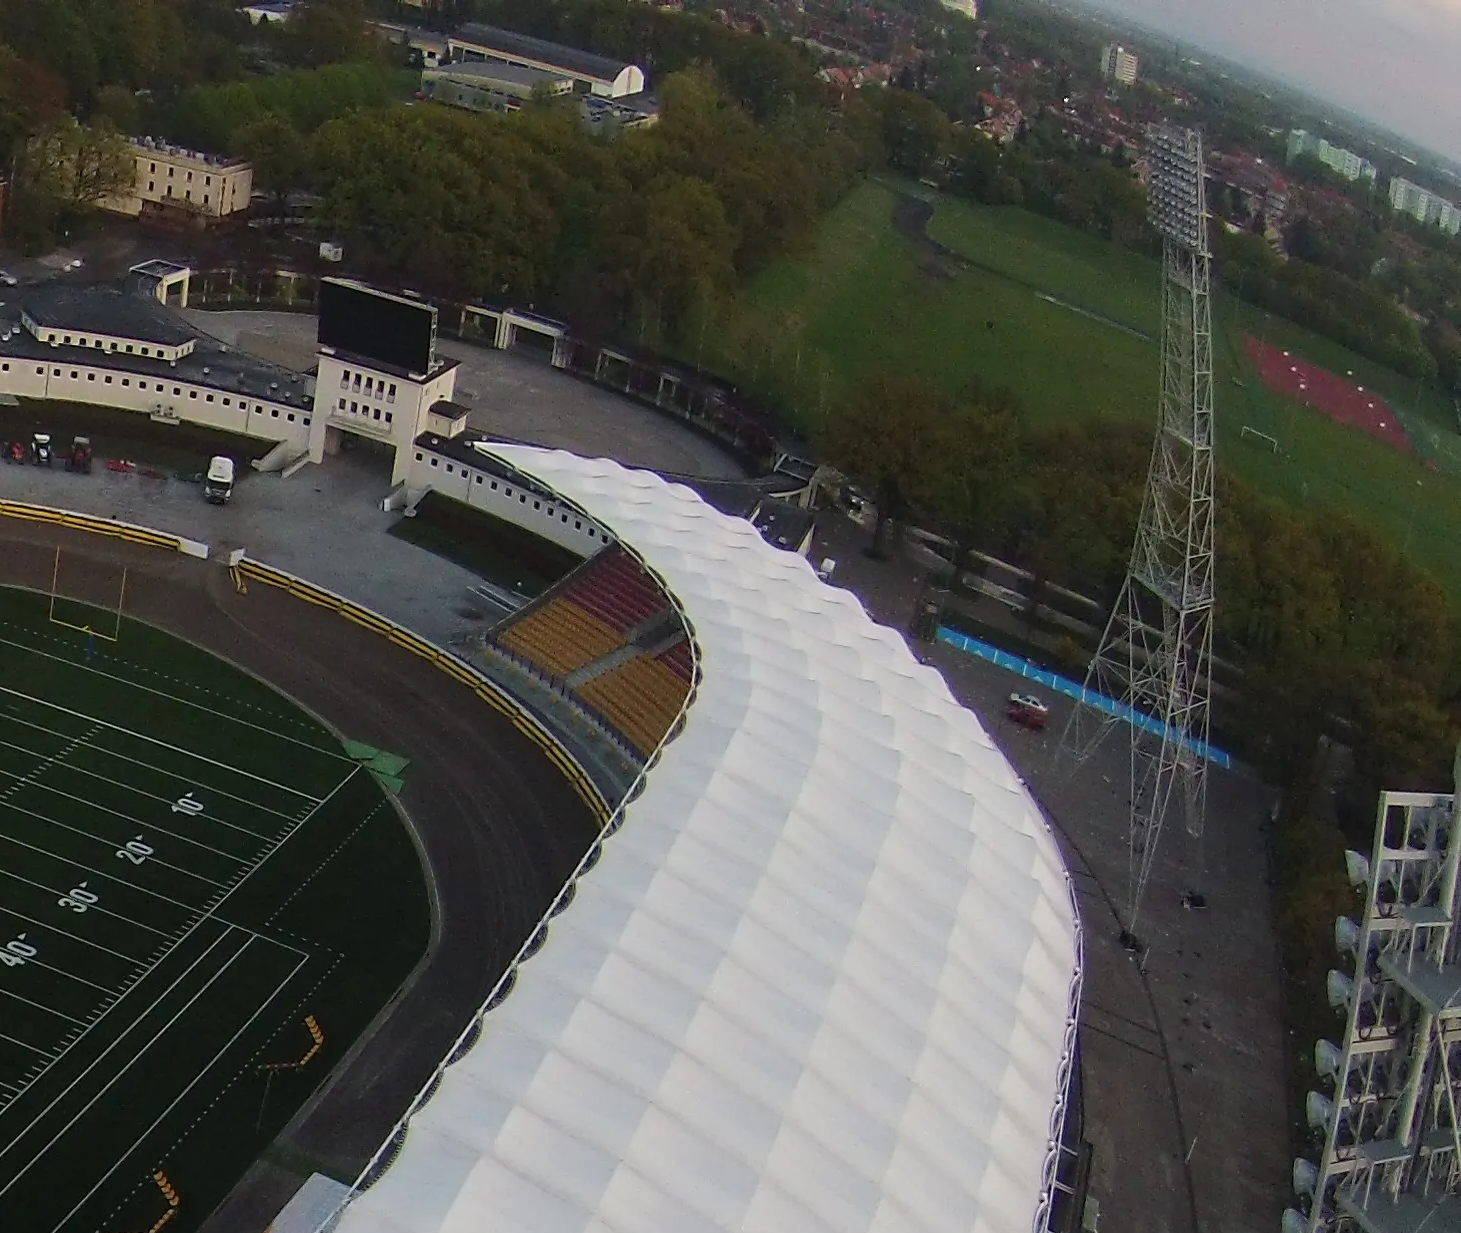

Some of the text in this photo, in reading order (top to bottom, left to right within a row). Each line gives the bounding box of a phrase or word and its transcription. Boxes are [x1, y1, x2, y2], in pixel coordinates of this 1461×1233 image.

[171, 797, 205, 817] 10
[115, 840, 155, 866] 20
[57, 886, 100, 915] 30
